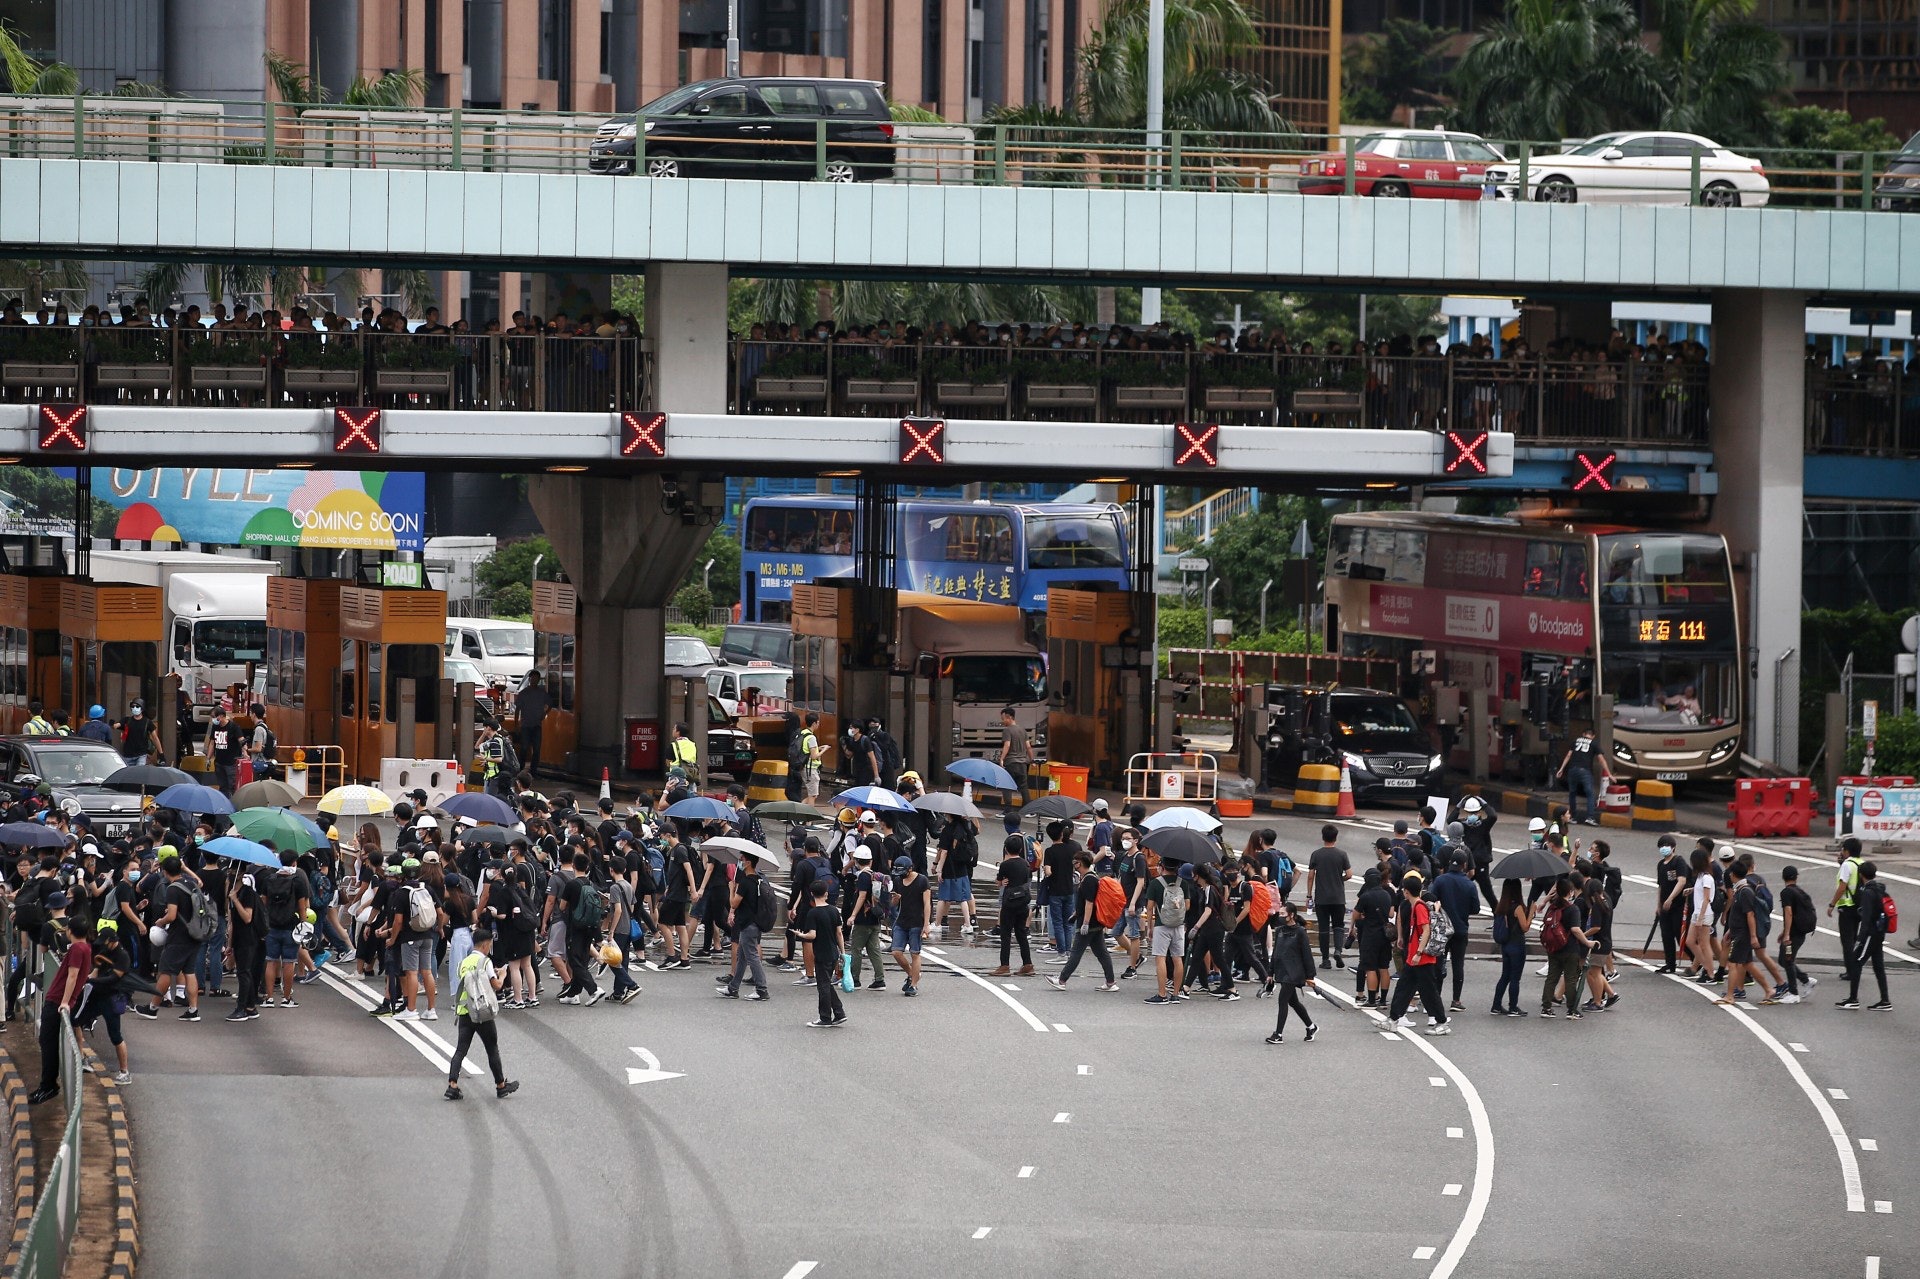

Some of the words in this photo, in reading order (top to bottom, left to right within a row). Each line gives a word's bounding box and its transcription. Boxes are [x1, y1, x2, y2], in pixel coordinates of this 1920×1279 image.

[292, 508, 363, 531] COMING
[369, 512, 419, 533] SOON
[245, 533, 273, 542] SHOPPING
[274, 534, 290, 543] MALL
[291, 535, 300, 543] OF
[301, 535, 319, 544] HANG
[320, 536, 338, 544] LUNG
[338, 537, 372, 546] PROPERTIES
[384, 564, 417, 585] POAD
[1382, 610, 1410, 626] foodpanda
[1539, 614, 1584, 640] foodpanda
[1679, 621, 1706, 640] 111
[636, 727, 652, 735] FIRE
[641, 742, 648, 751] 5
